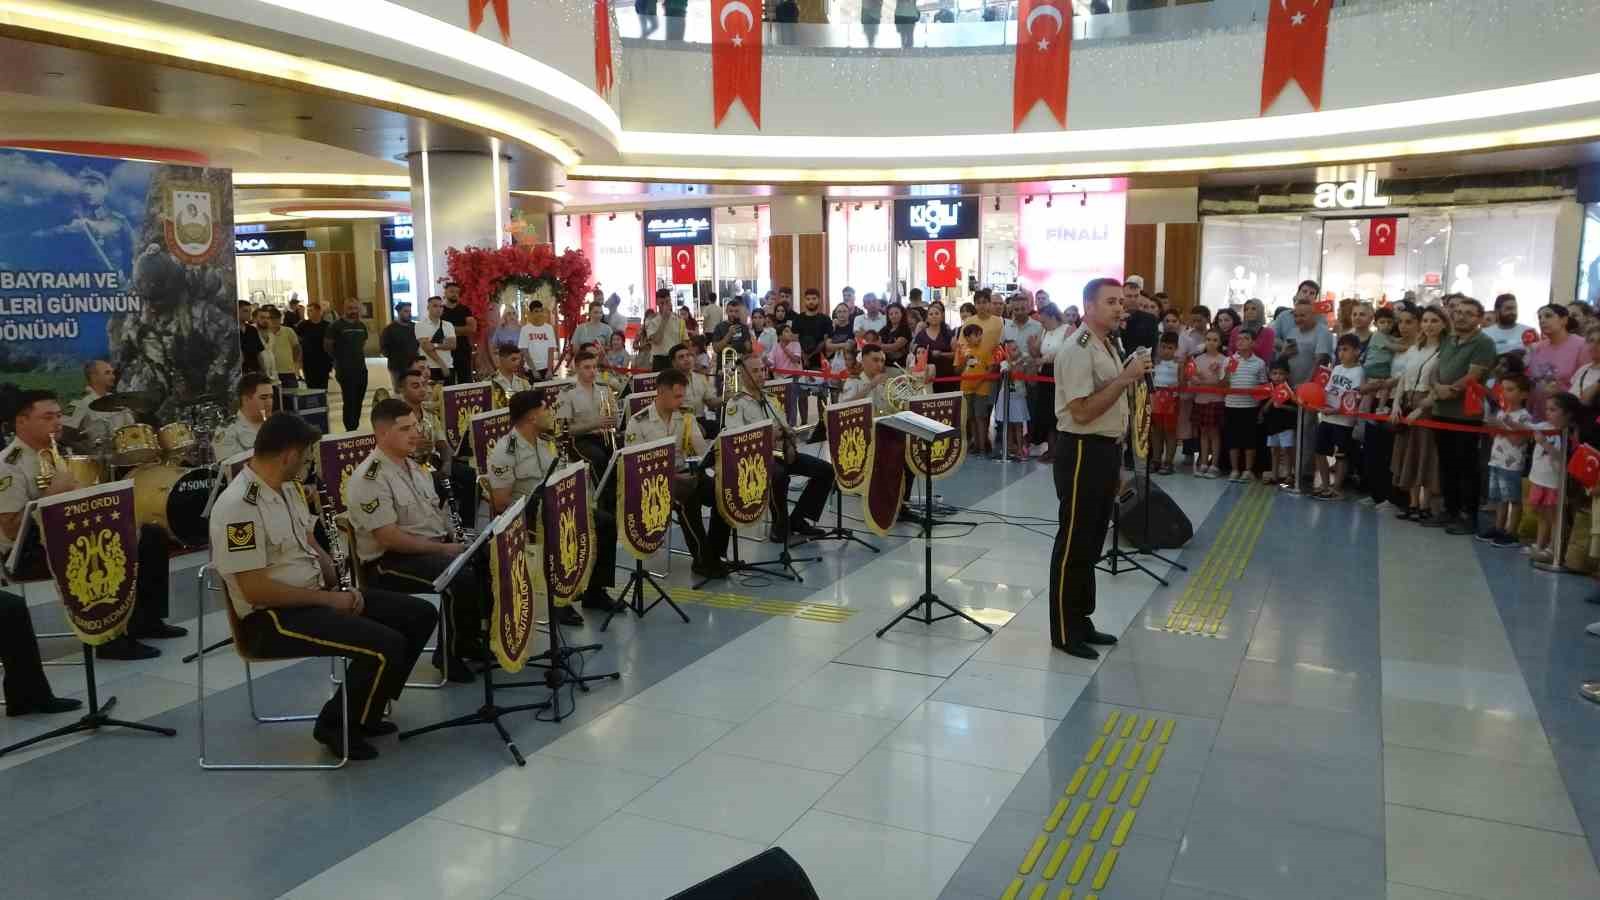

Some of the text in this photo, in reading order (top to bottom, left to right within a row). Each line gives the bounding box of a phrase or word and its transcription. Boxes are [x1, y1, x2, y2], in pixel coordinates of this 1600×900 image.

[1, 271, 119, 289] BAYRAMI VE
[48, 292, 141, 314] GÜNÜNÜN
[0, 318, 80, 341] ÖNÜMÜ
